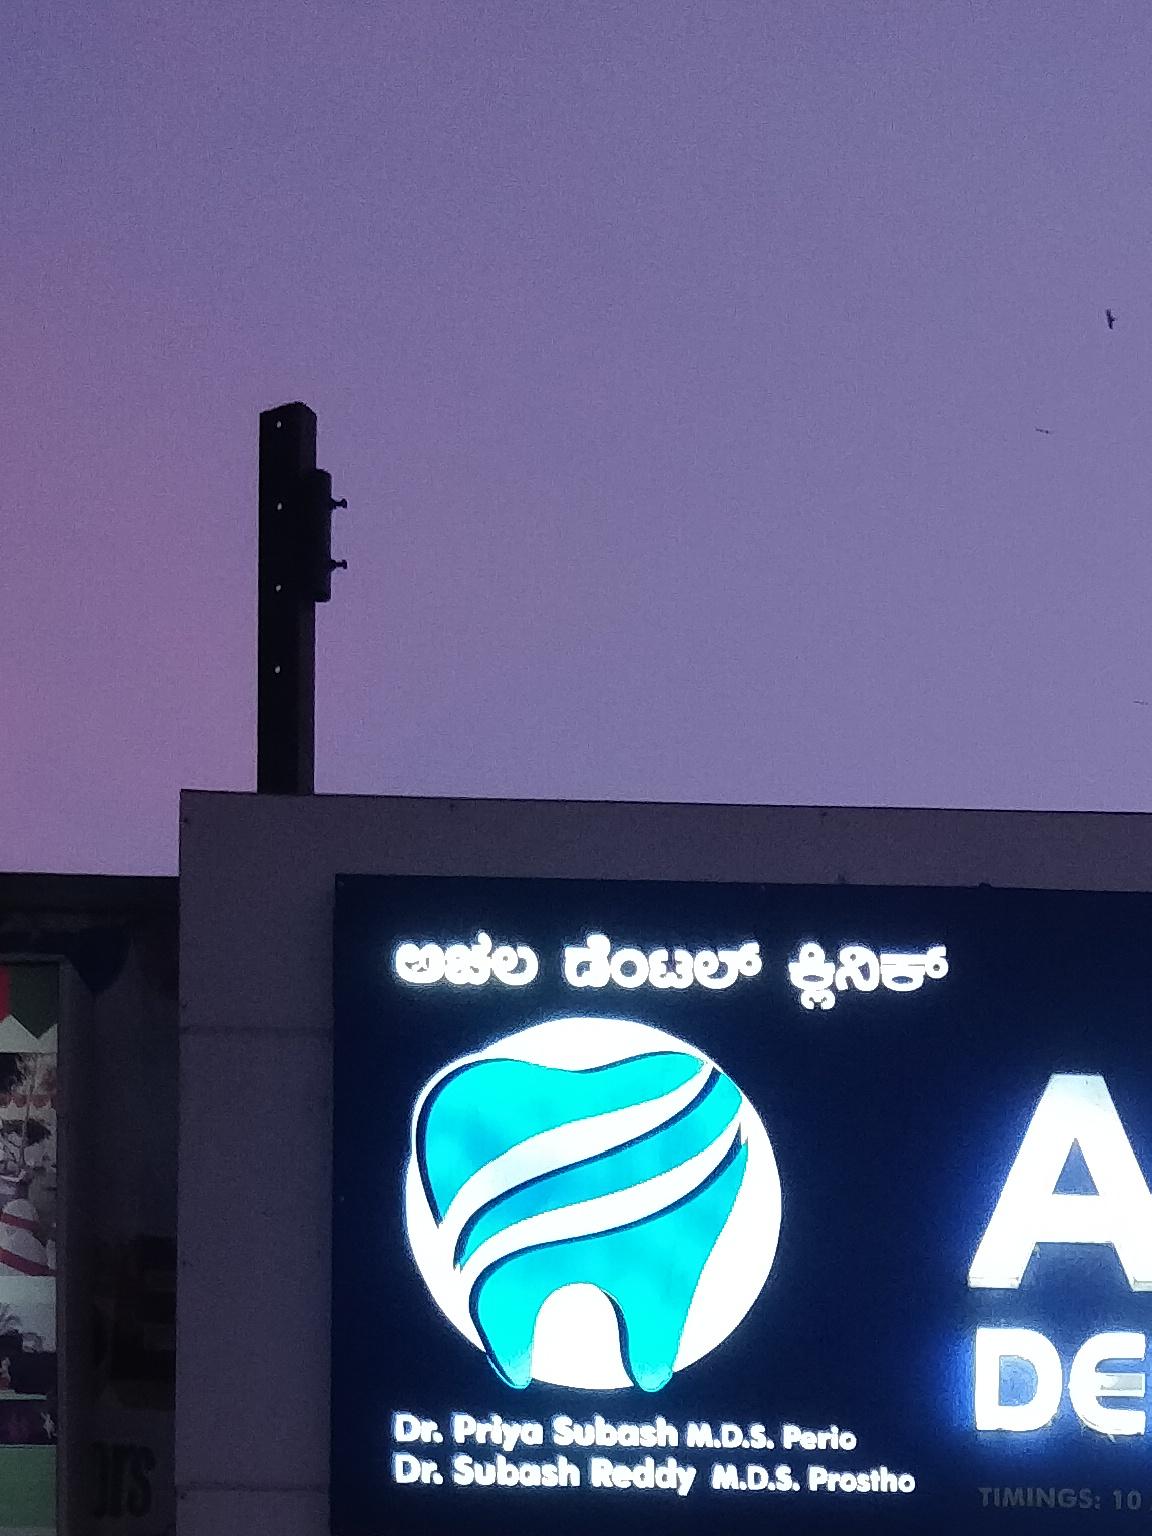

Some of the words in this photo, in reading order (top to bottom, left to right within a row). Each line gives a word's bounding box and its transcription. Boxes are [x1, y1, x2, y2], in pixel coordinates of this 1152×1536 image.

[395, 932, 538, 986] ಅಚಲ
[563, 934, 761, 990] ಡೆಂಟಲ್
[789, 943, 948, 1010] ಕ್ಲಿನಿಕ್
[393, 1413, 443, 1445] Dr.
[453, 1414, 543, 1451] Priya
[552, 1416, 679, 1448] Subash
[686, 1421, 775, 1450] M.D.S.
[782, 1424, 857, 1451] Perio
[393, 1453, 443, 1485] Dr.
[453, 1454, 580, 1488] Subash
[591, 1458, 697, 1496] Reddy
[711, 1463, 800, 1491] M.D.S.
[808, 1465, 916, 1494] Prostho
[979, 1487, 1100, 1510] TIMINGS:
[1113, 1490, 1142, 1511] 10
